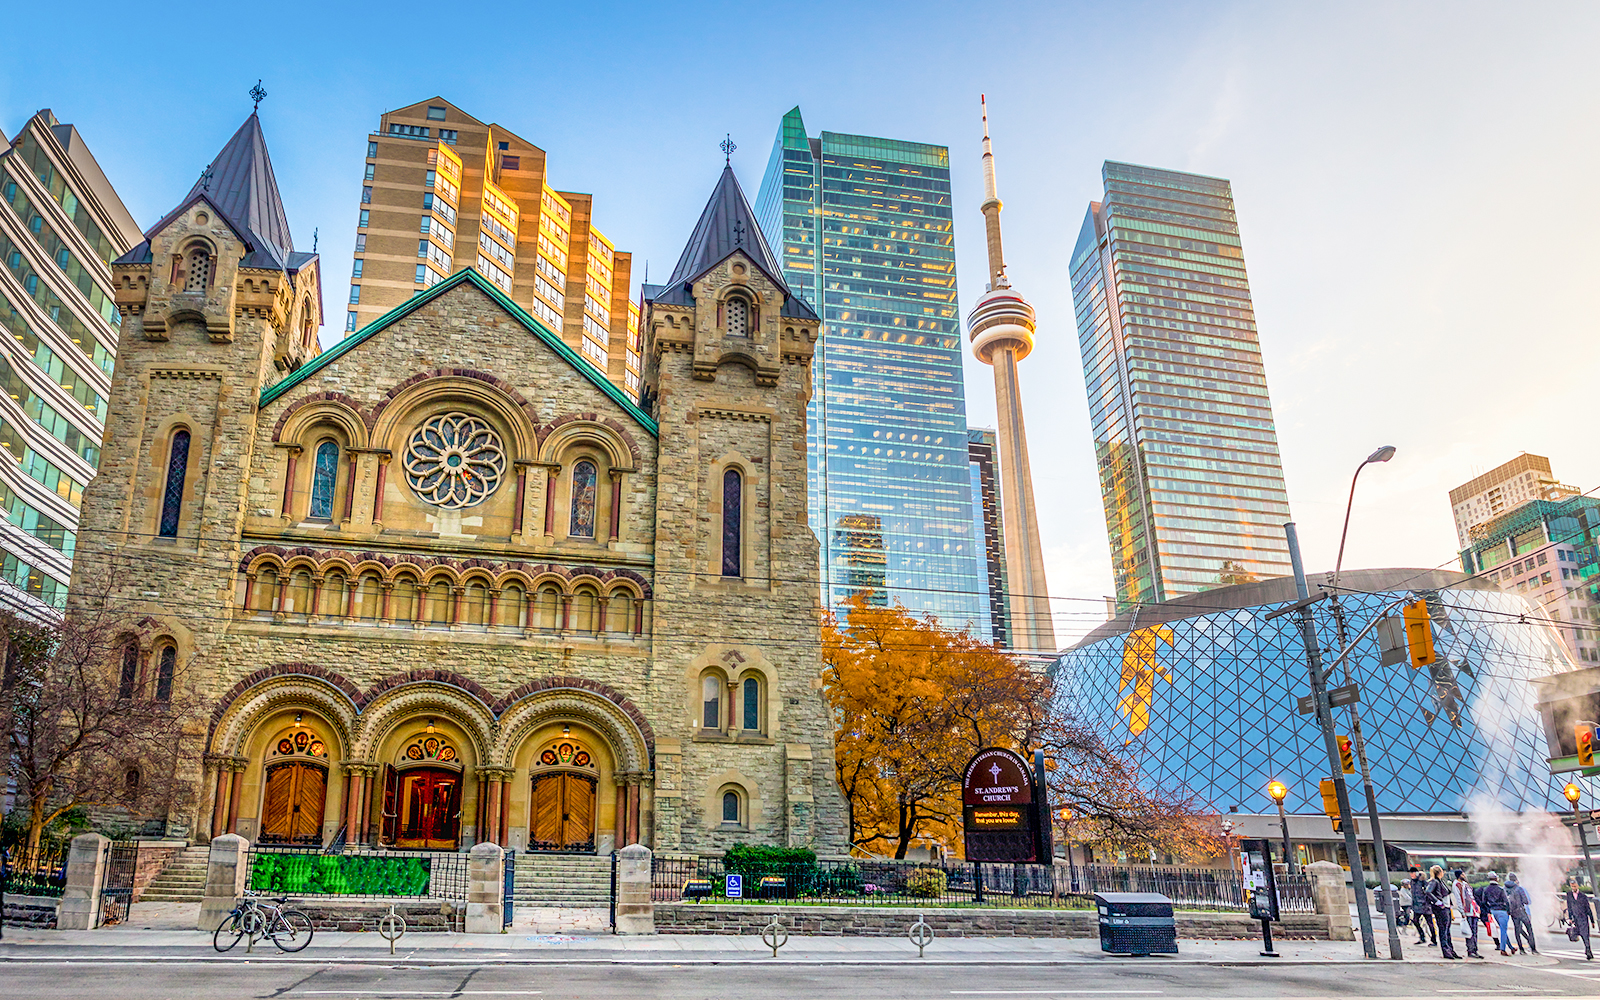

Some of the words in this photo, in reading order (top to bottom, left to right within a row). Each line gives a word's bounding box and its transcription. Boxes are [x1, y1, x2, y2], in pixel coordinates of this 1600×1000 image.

[966, 751, 993, 778] PRESBYTERIAN
[993, 751, 1013, 761] CHURCH
[1016, 763, 1029, 786] CANADA
[983, 794, 1011, 802] CHURCH
